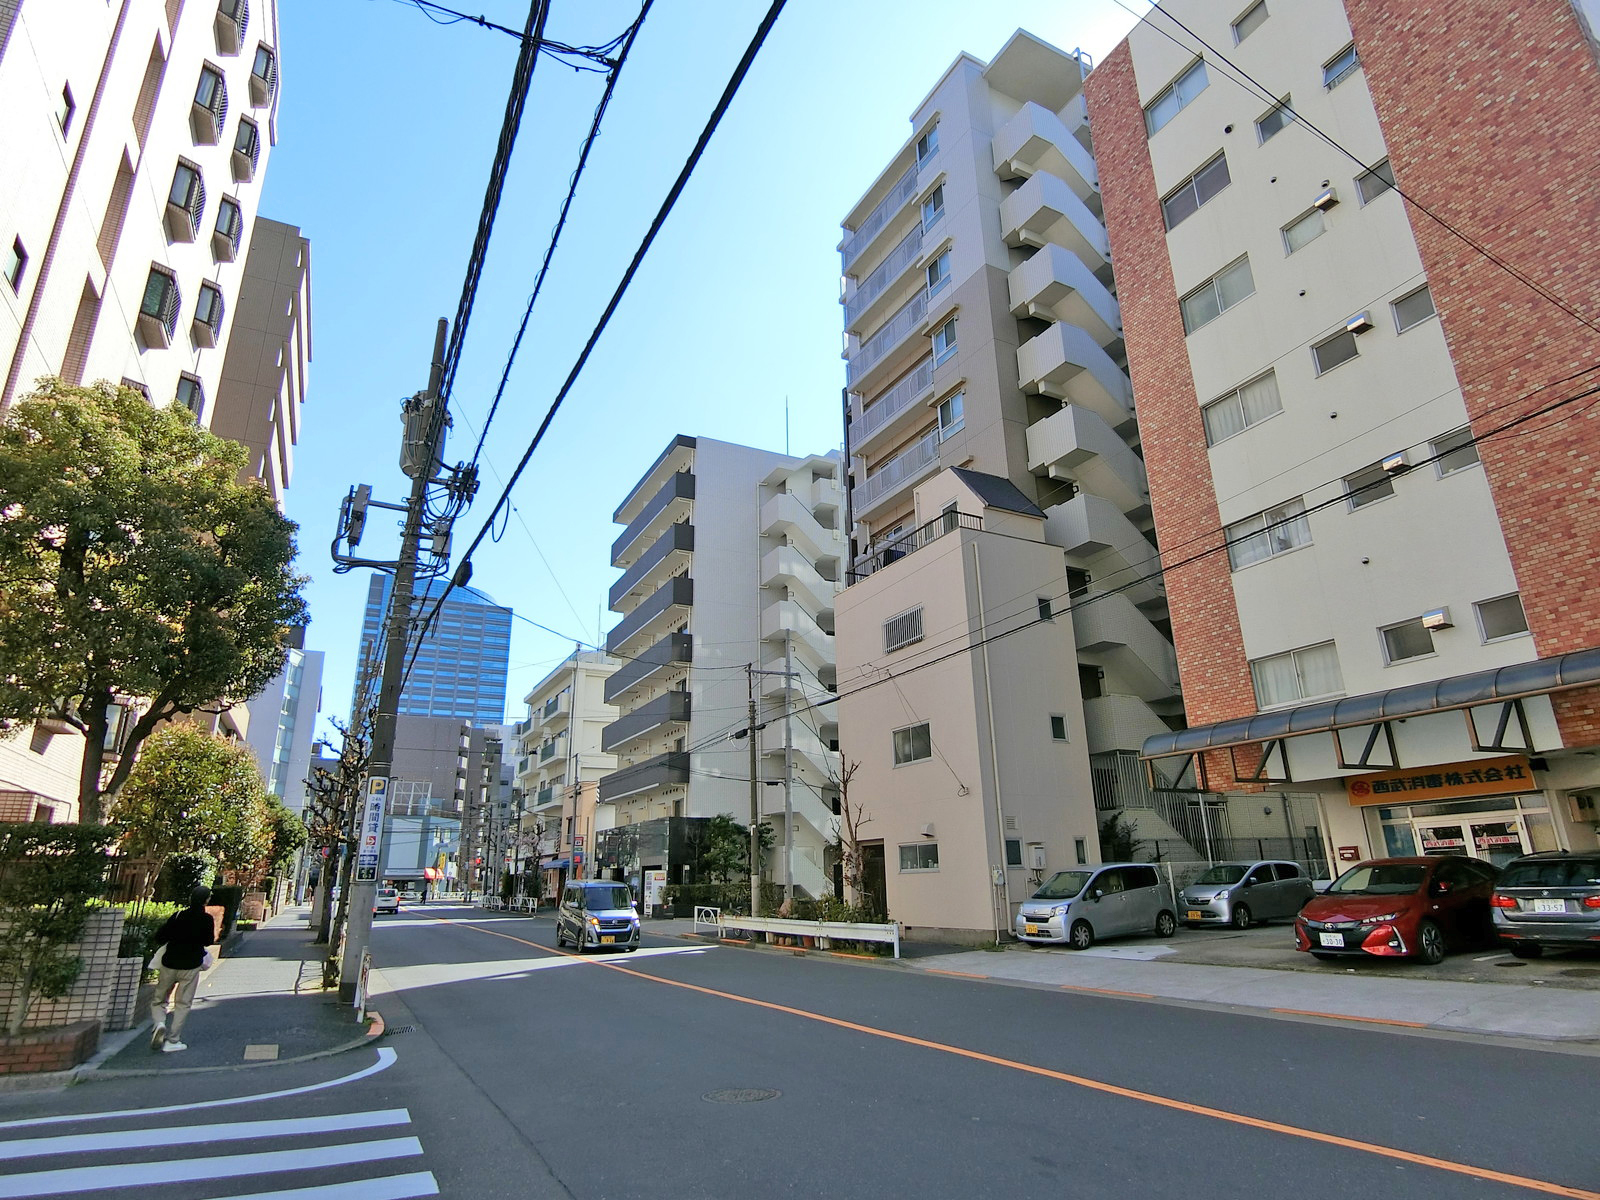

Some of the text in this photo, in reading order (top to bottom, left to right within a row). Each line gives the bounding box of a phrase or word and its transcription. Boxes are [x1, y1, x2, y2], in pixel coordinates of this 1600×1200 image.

[371, 779, 385, 794] P
[367, 802, 380, 833] 時間貸
